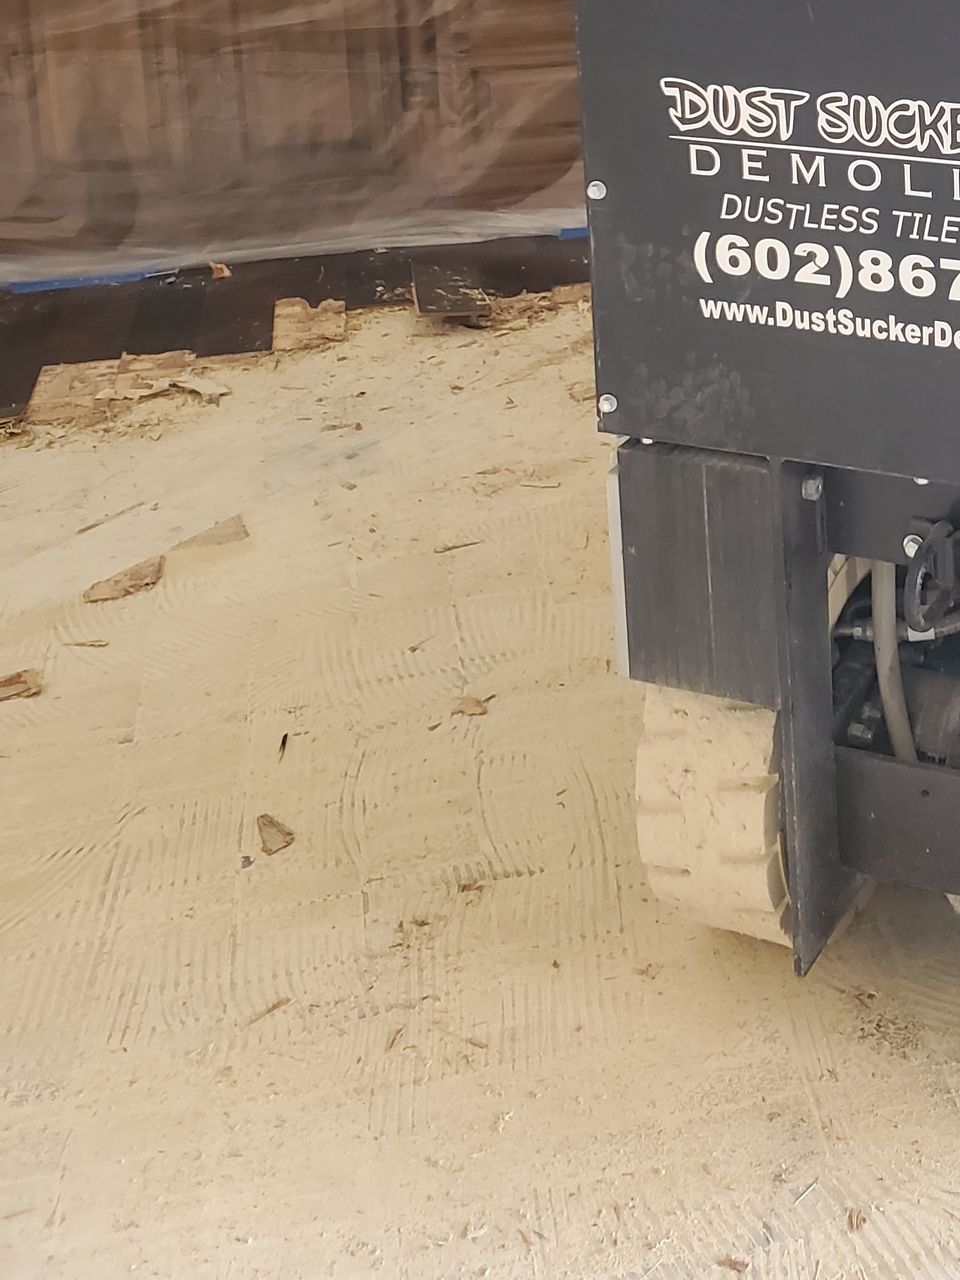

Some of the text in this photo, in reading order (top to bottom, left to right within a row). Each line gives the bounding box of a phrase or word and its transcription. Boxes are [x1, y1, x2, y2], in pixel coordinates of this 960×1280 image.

[660, 77, 809, 141] DUST
[720, 194, 879, 232] DUSTLESS
[892, 210, 960, 245] TILE
